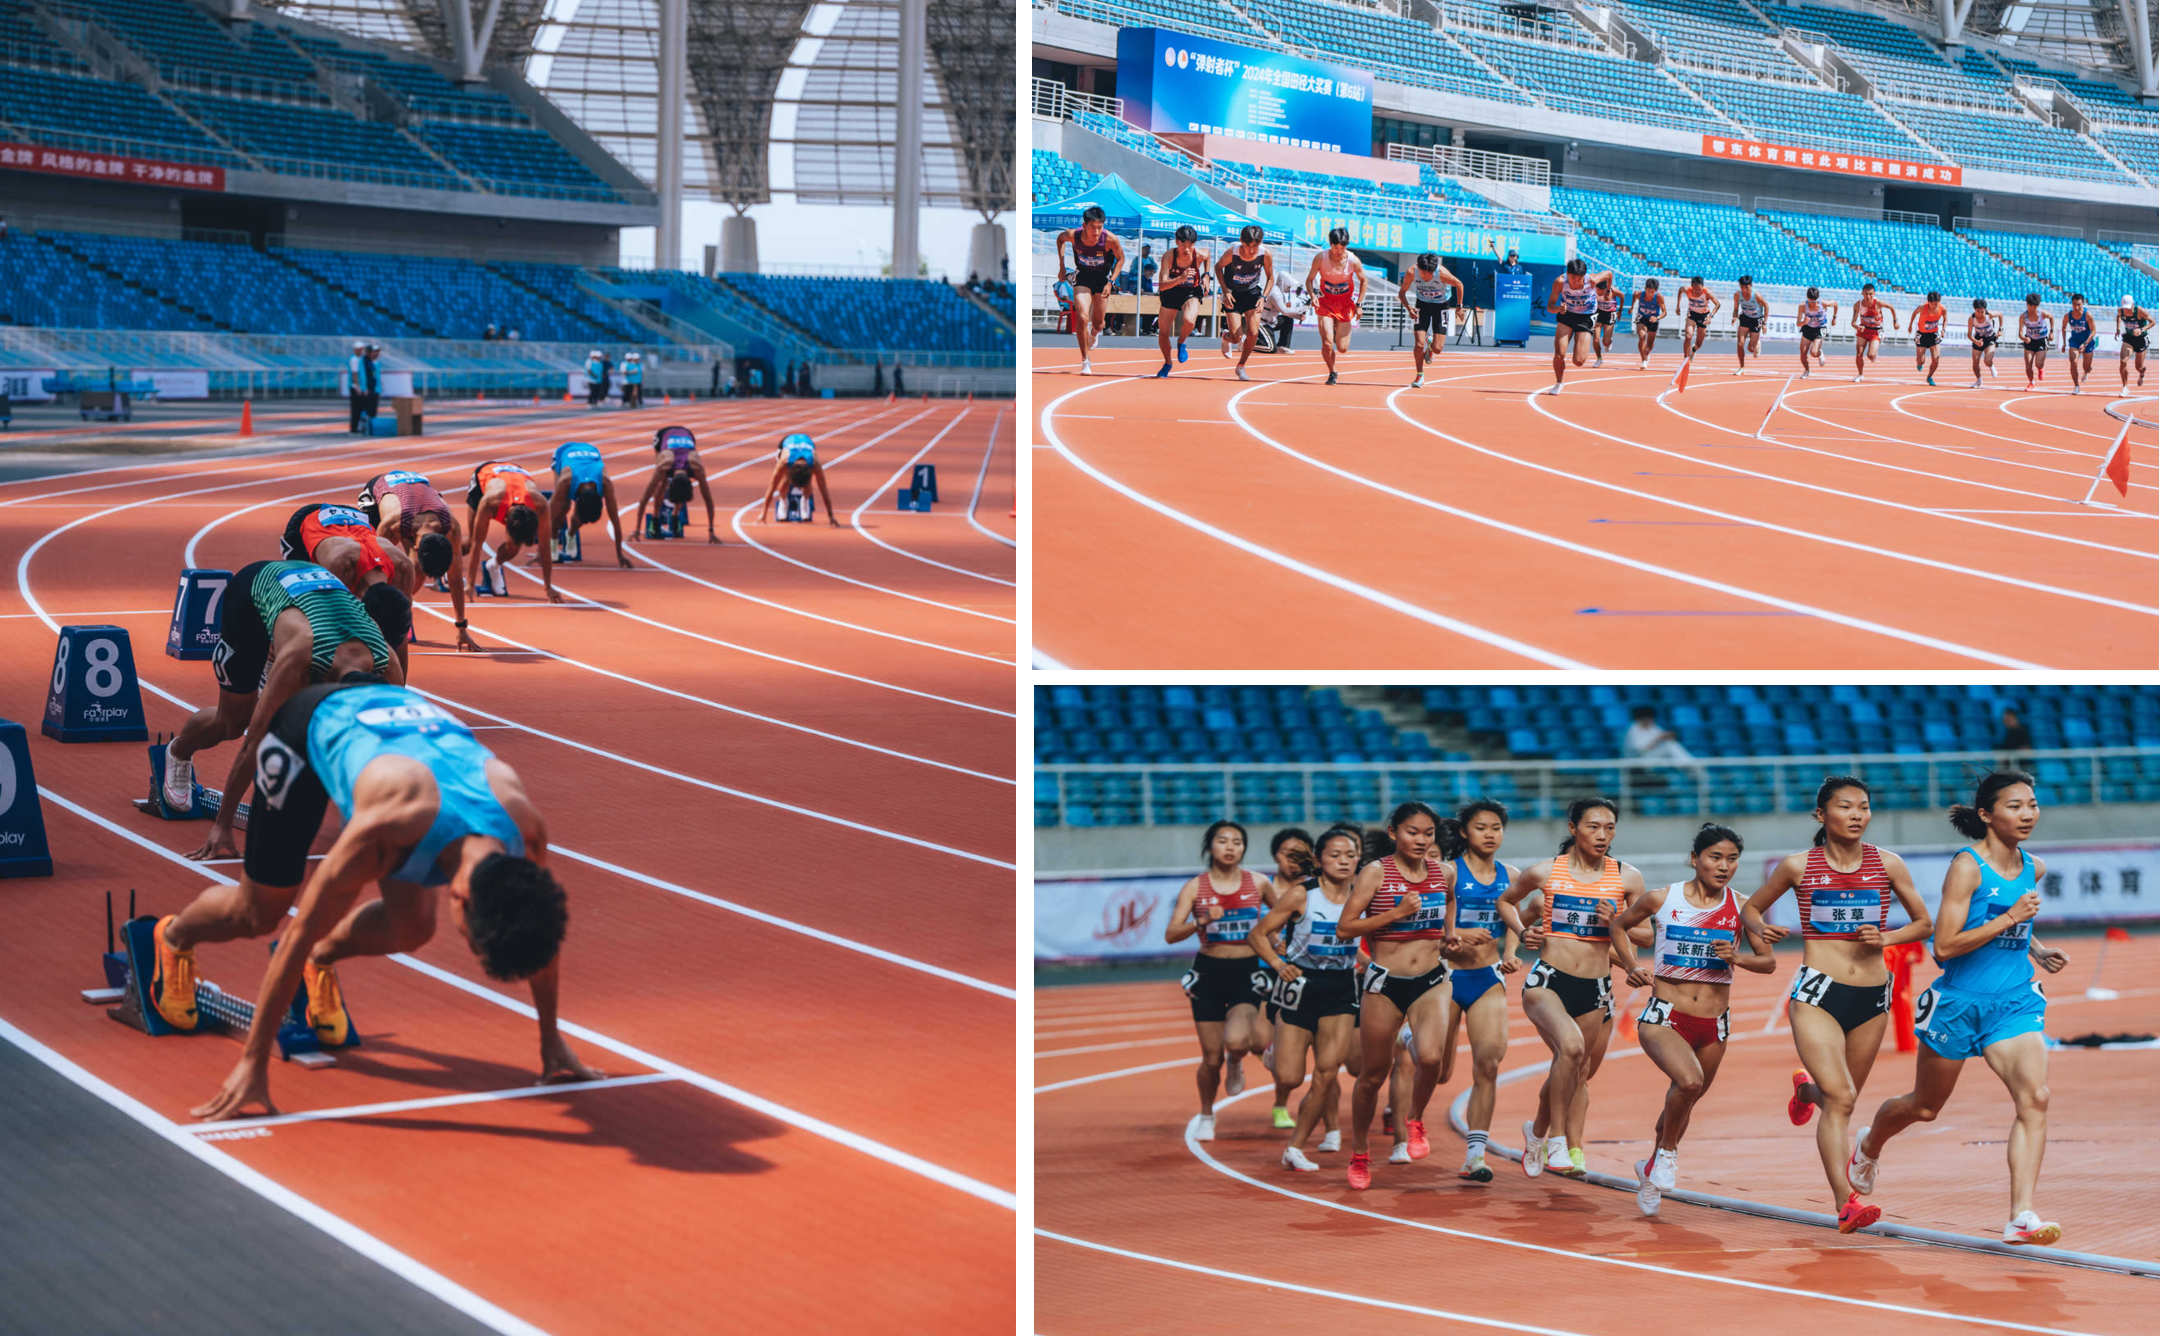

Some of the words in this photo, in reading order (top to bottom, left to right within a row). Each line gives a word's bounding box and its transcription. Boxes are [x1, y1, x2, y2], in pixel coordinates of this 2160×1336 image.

[197, 579, 228, 625] 7
[53, 636, 70, 695] 8
[84, 638, 123, 698] 8
[1684, 958, 1708, 967] 219
